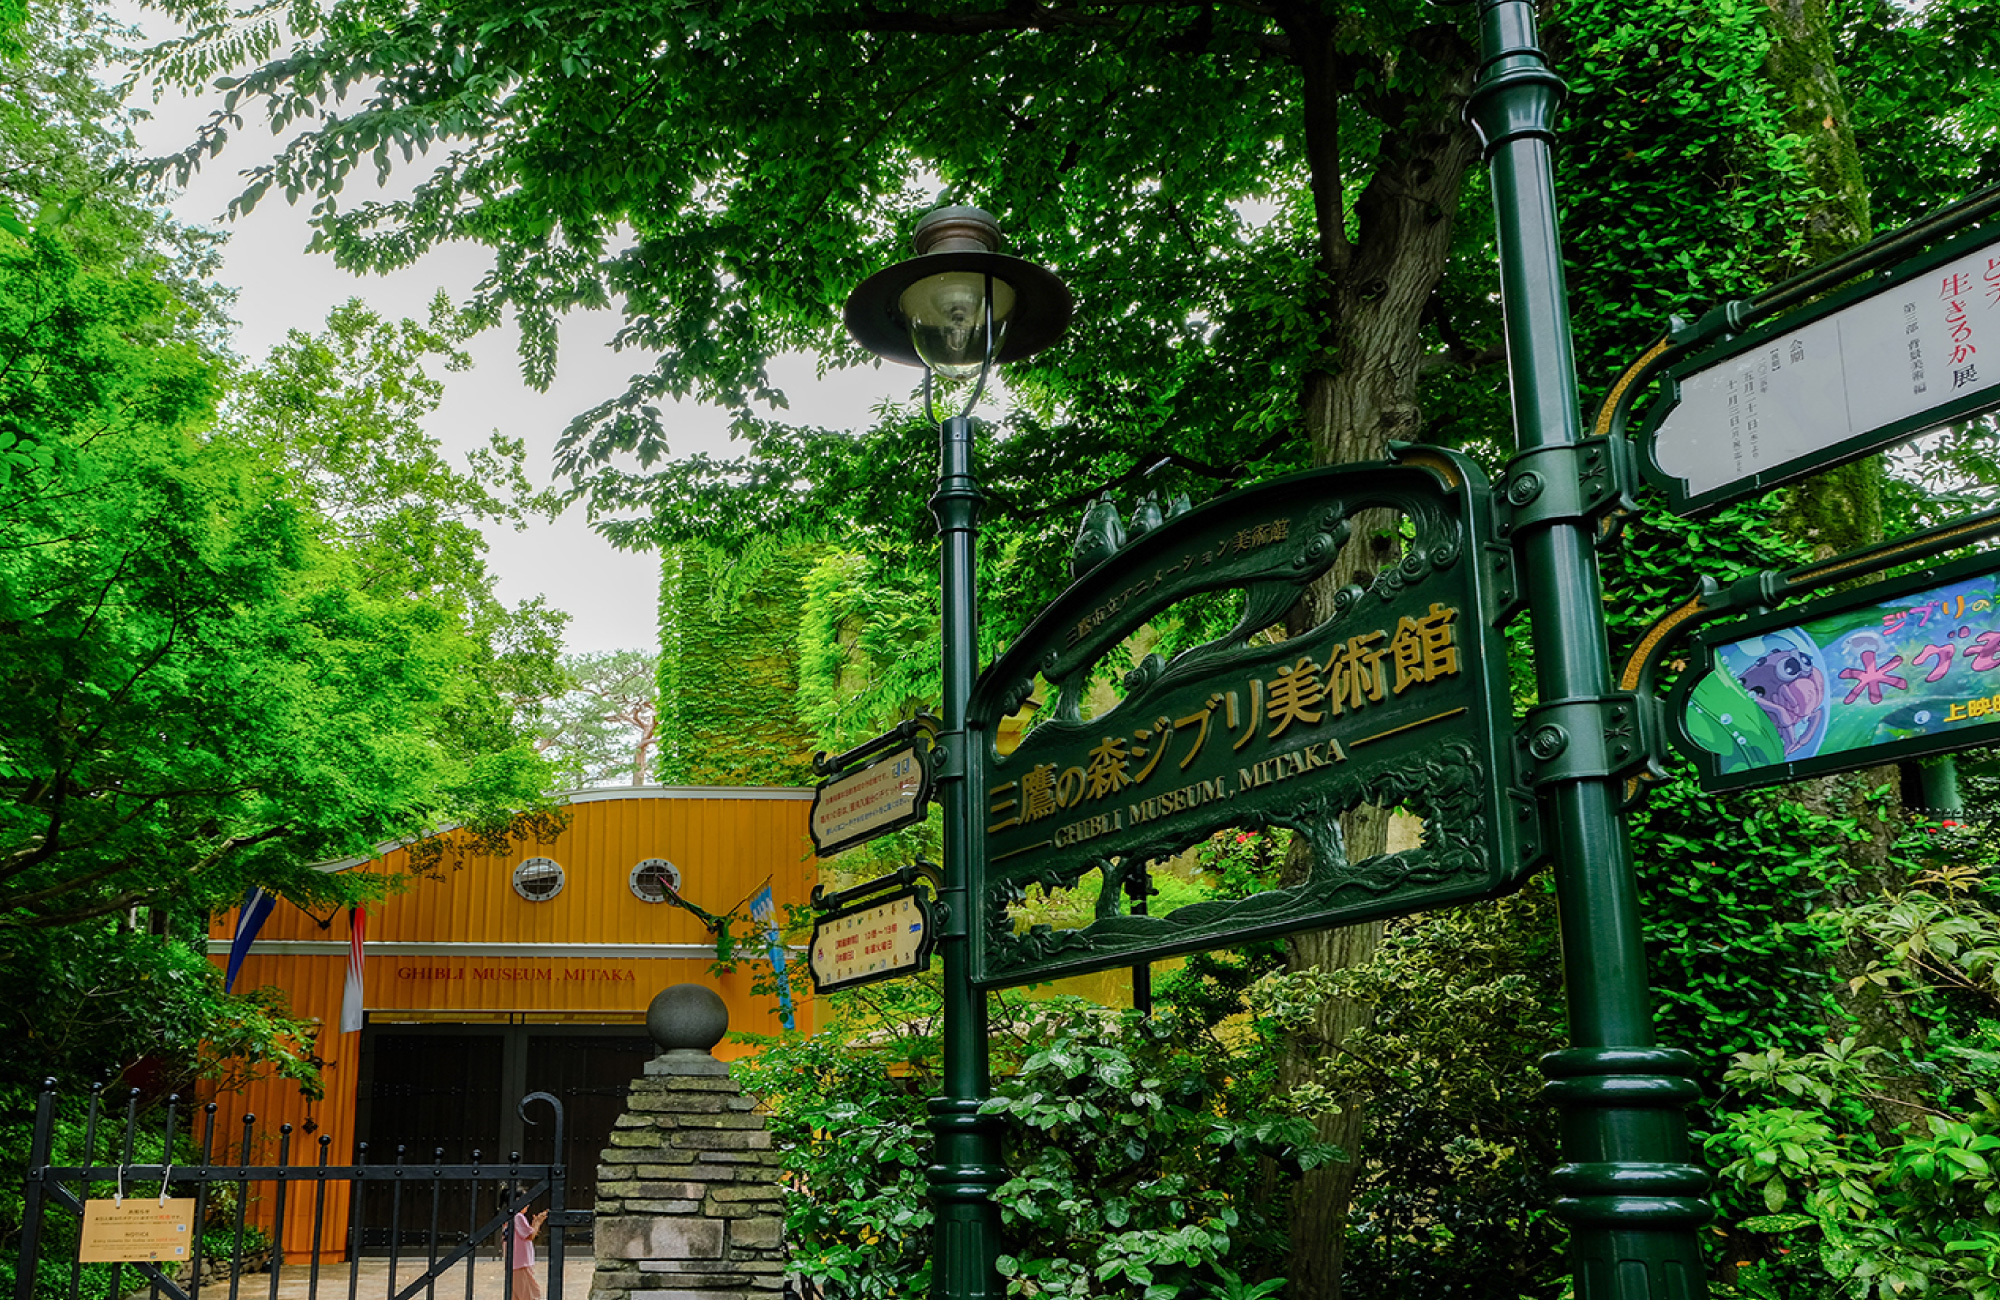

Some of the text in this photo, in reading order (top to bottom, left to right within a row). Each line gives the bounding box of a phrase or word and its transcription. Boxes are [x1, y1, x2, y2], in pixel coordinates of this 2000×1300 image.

[1938, 272, 1980, 393] 生きるか展
[987, 602, 1461, 833] 三鷹の森ジブリ美術館
[1053, 808, 1123, 849] GHIBLI
[1238, 737, 1347, 794] MITAKA
[398, 966, 464, 981] GHIBLI
[564, 968, 635, 982] MITAKA
